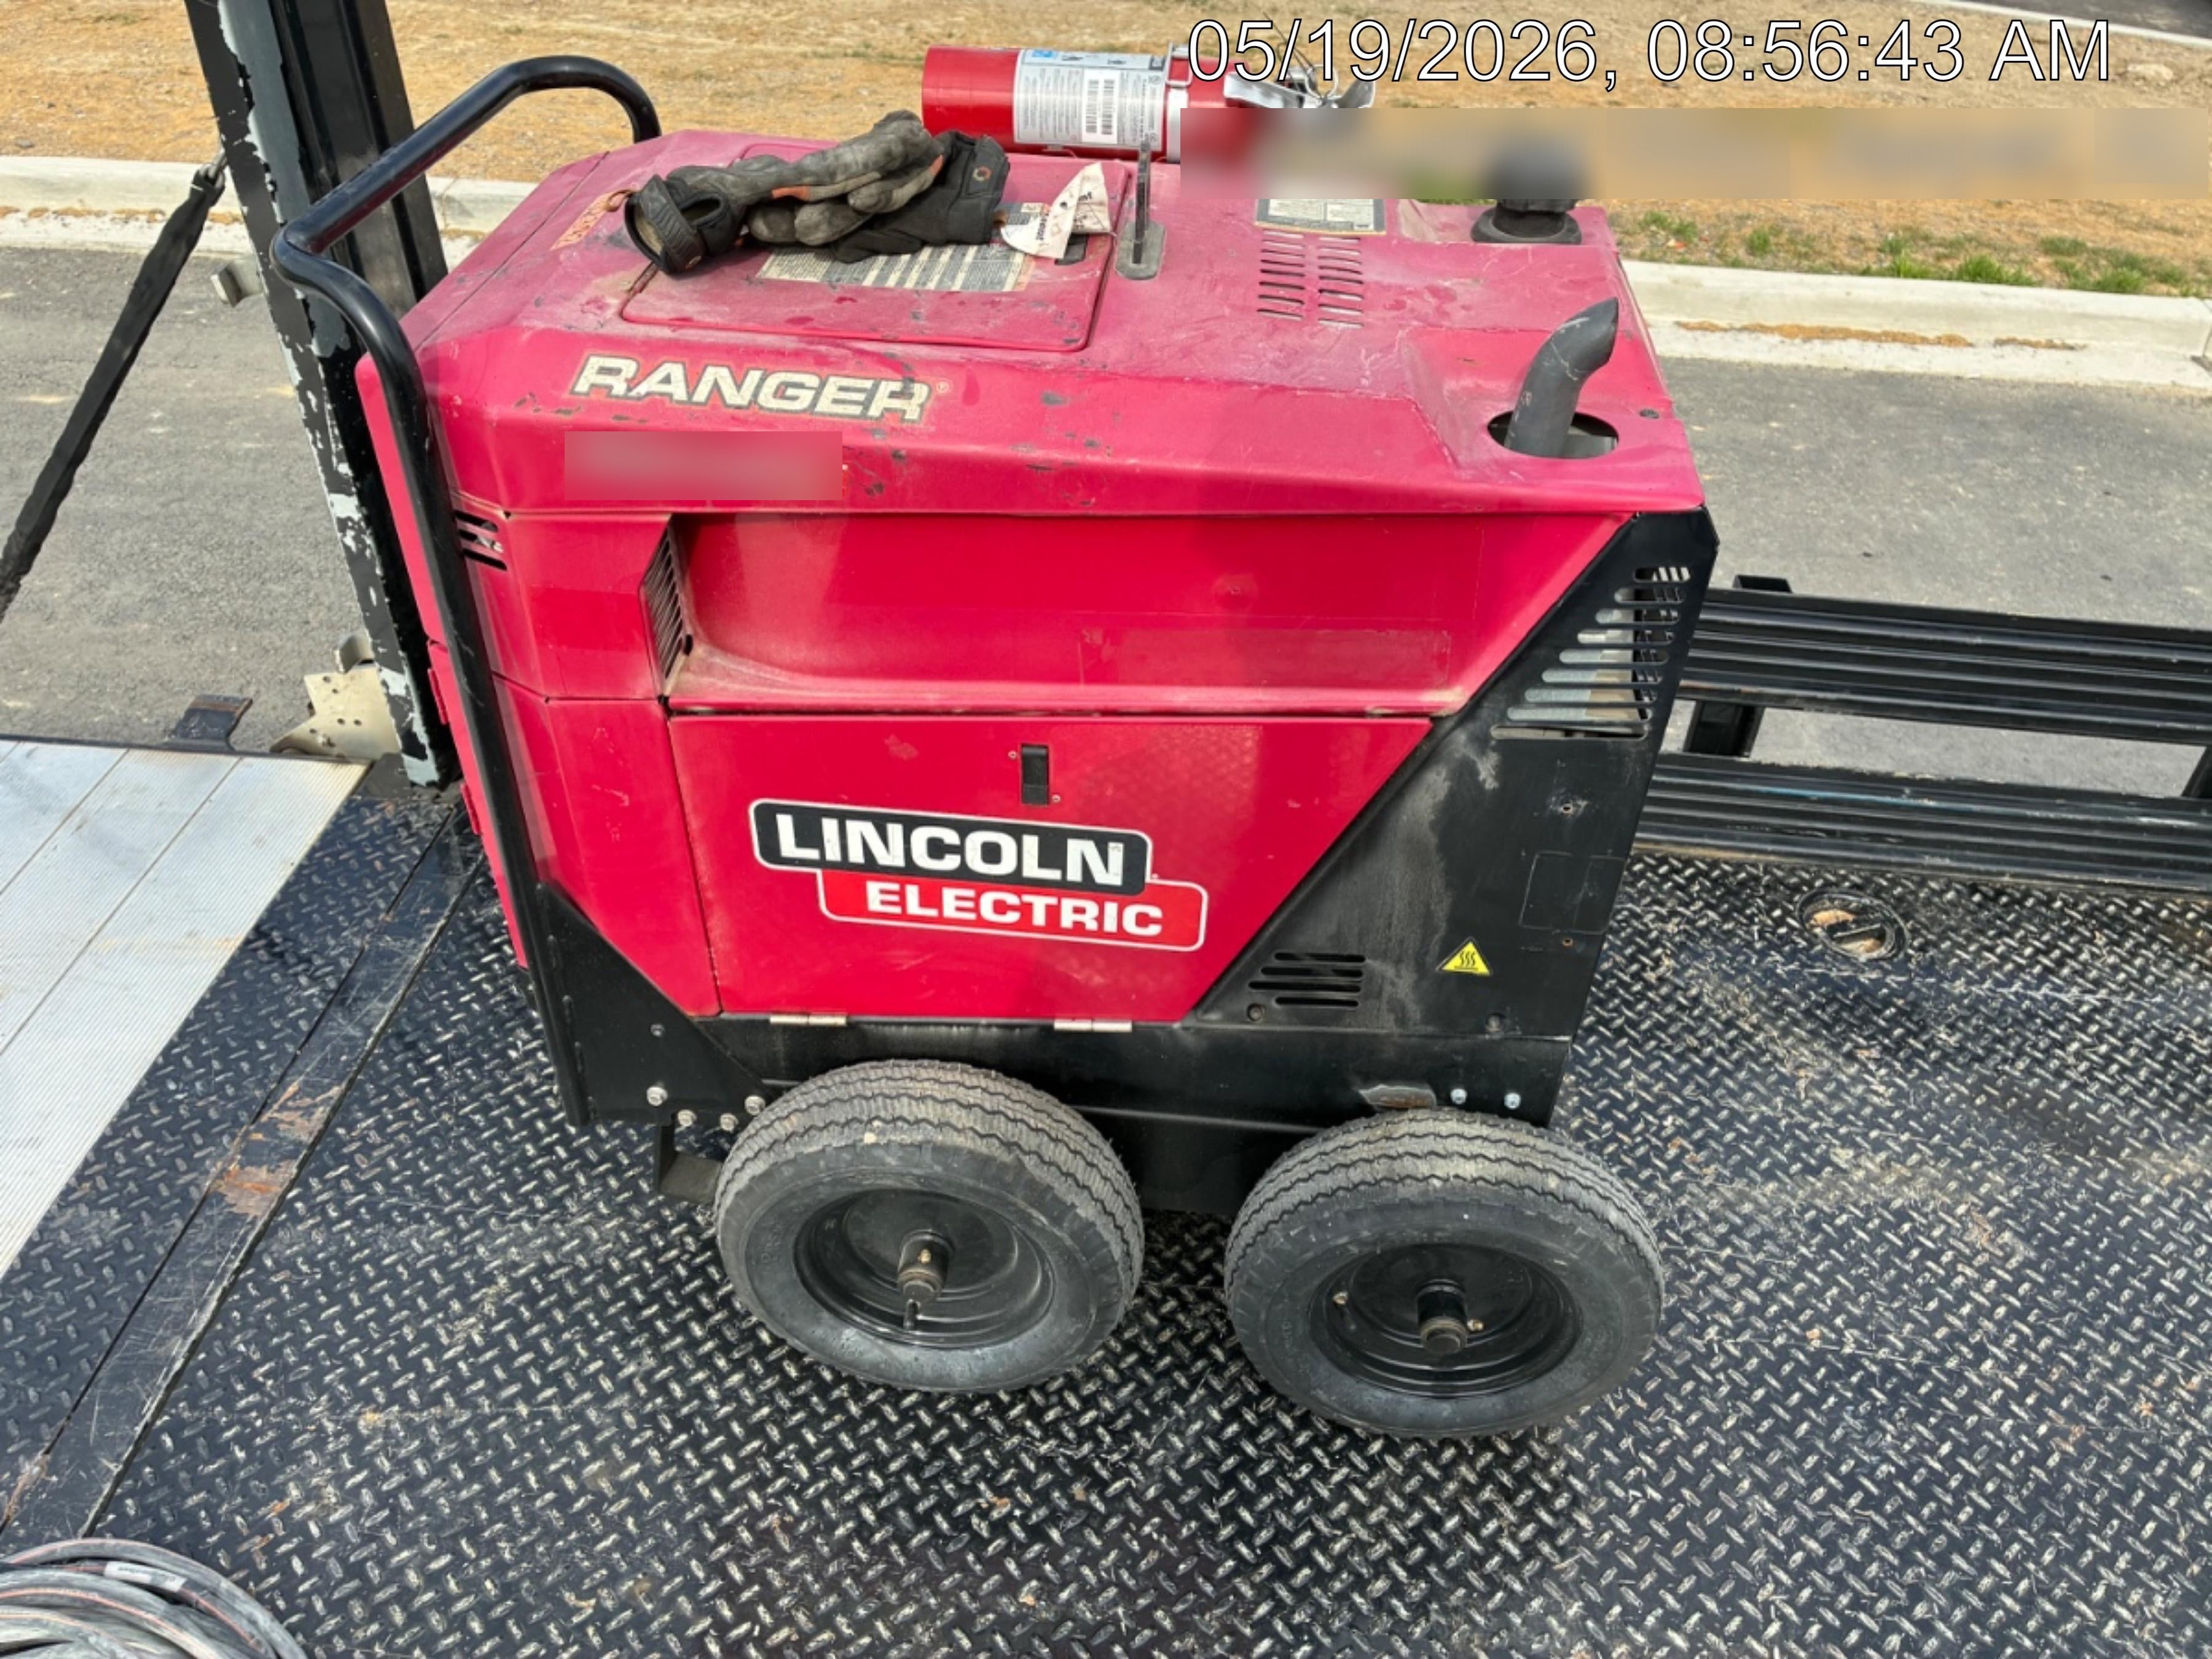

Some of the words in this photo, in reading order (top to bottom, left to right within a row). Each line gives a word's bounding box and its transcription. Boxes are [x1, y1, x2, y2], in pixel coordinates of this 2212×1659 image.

[571, 353, 931, 422] RANGER
[775, 813, 1124, 887] LINCOLN
[866, 880, 1163, 936] ELECTRIC
